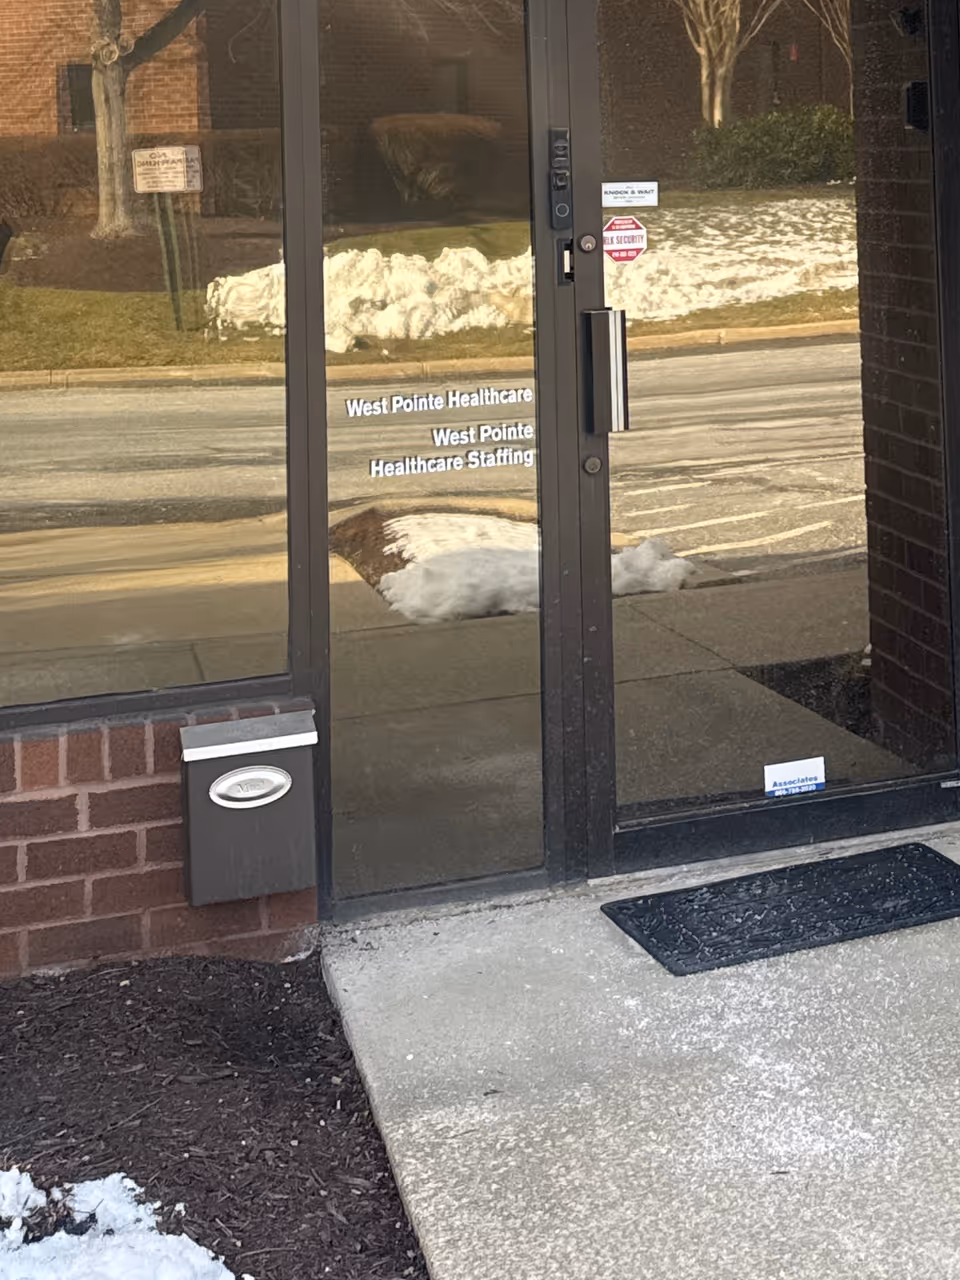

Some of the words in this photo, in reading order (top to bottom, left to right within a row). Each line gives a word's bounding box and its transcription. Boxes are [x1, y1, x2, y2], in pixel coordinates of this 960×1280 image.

[616, 234, 645, 245] SECURITY
[346, 398, 388, 417] West
[391, 394, 444, 413] Pointe
[448, 388, 533, 409] Healthcare
[432, 427, 476, 446] West
[479, 423, 534, 442] Pointe
[370, 455, 464, 477] Healthcare
[468, 449, 534, 468] Staffing
[772, 776, 819, 788] Associates
